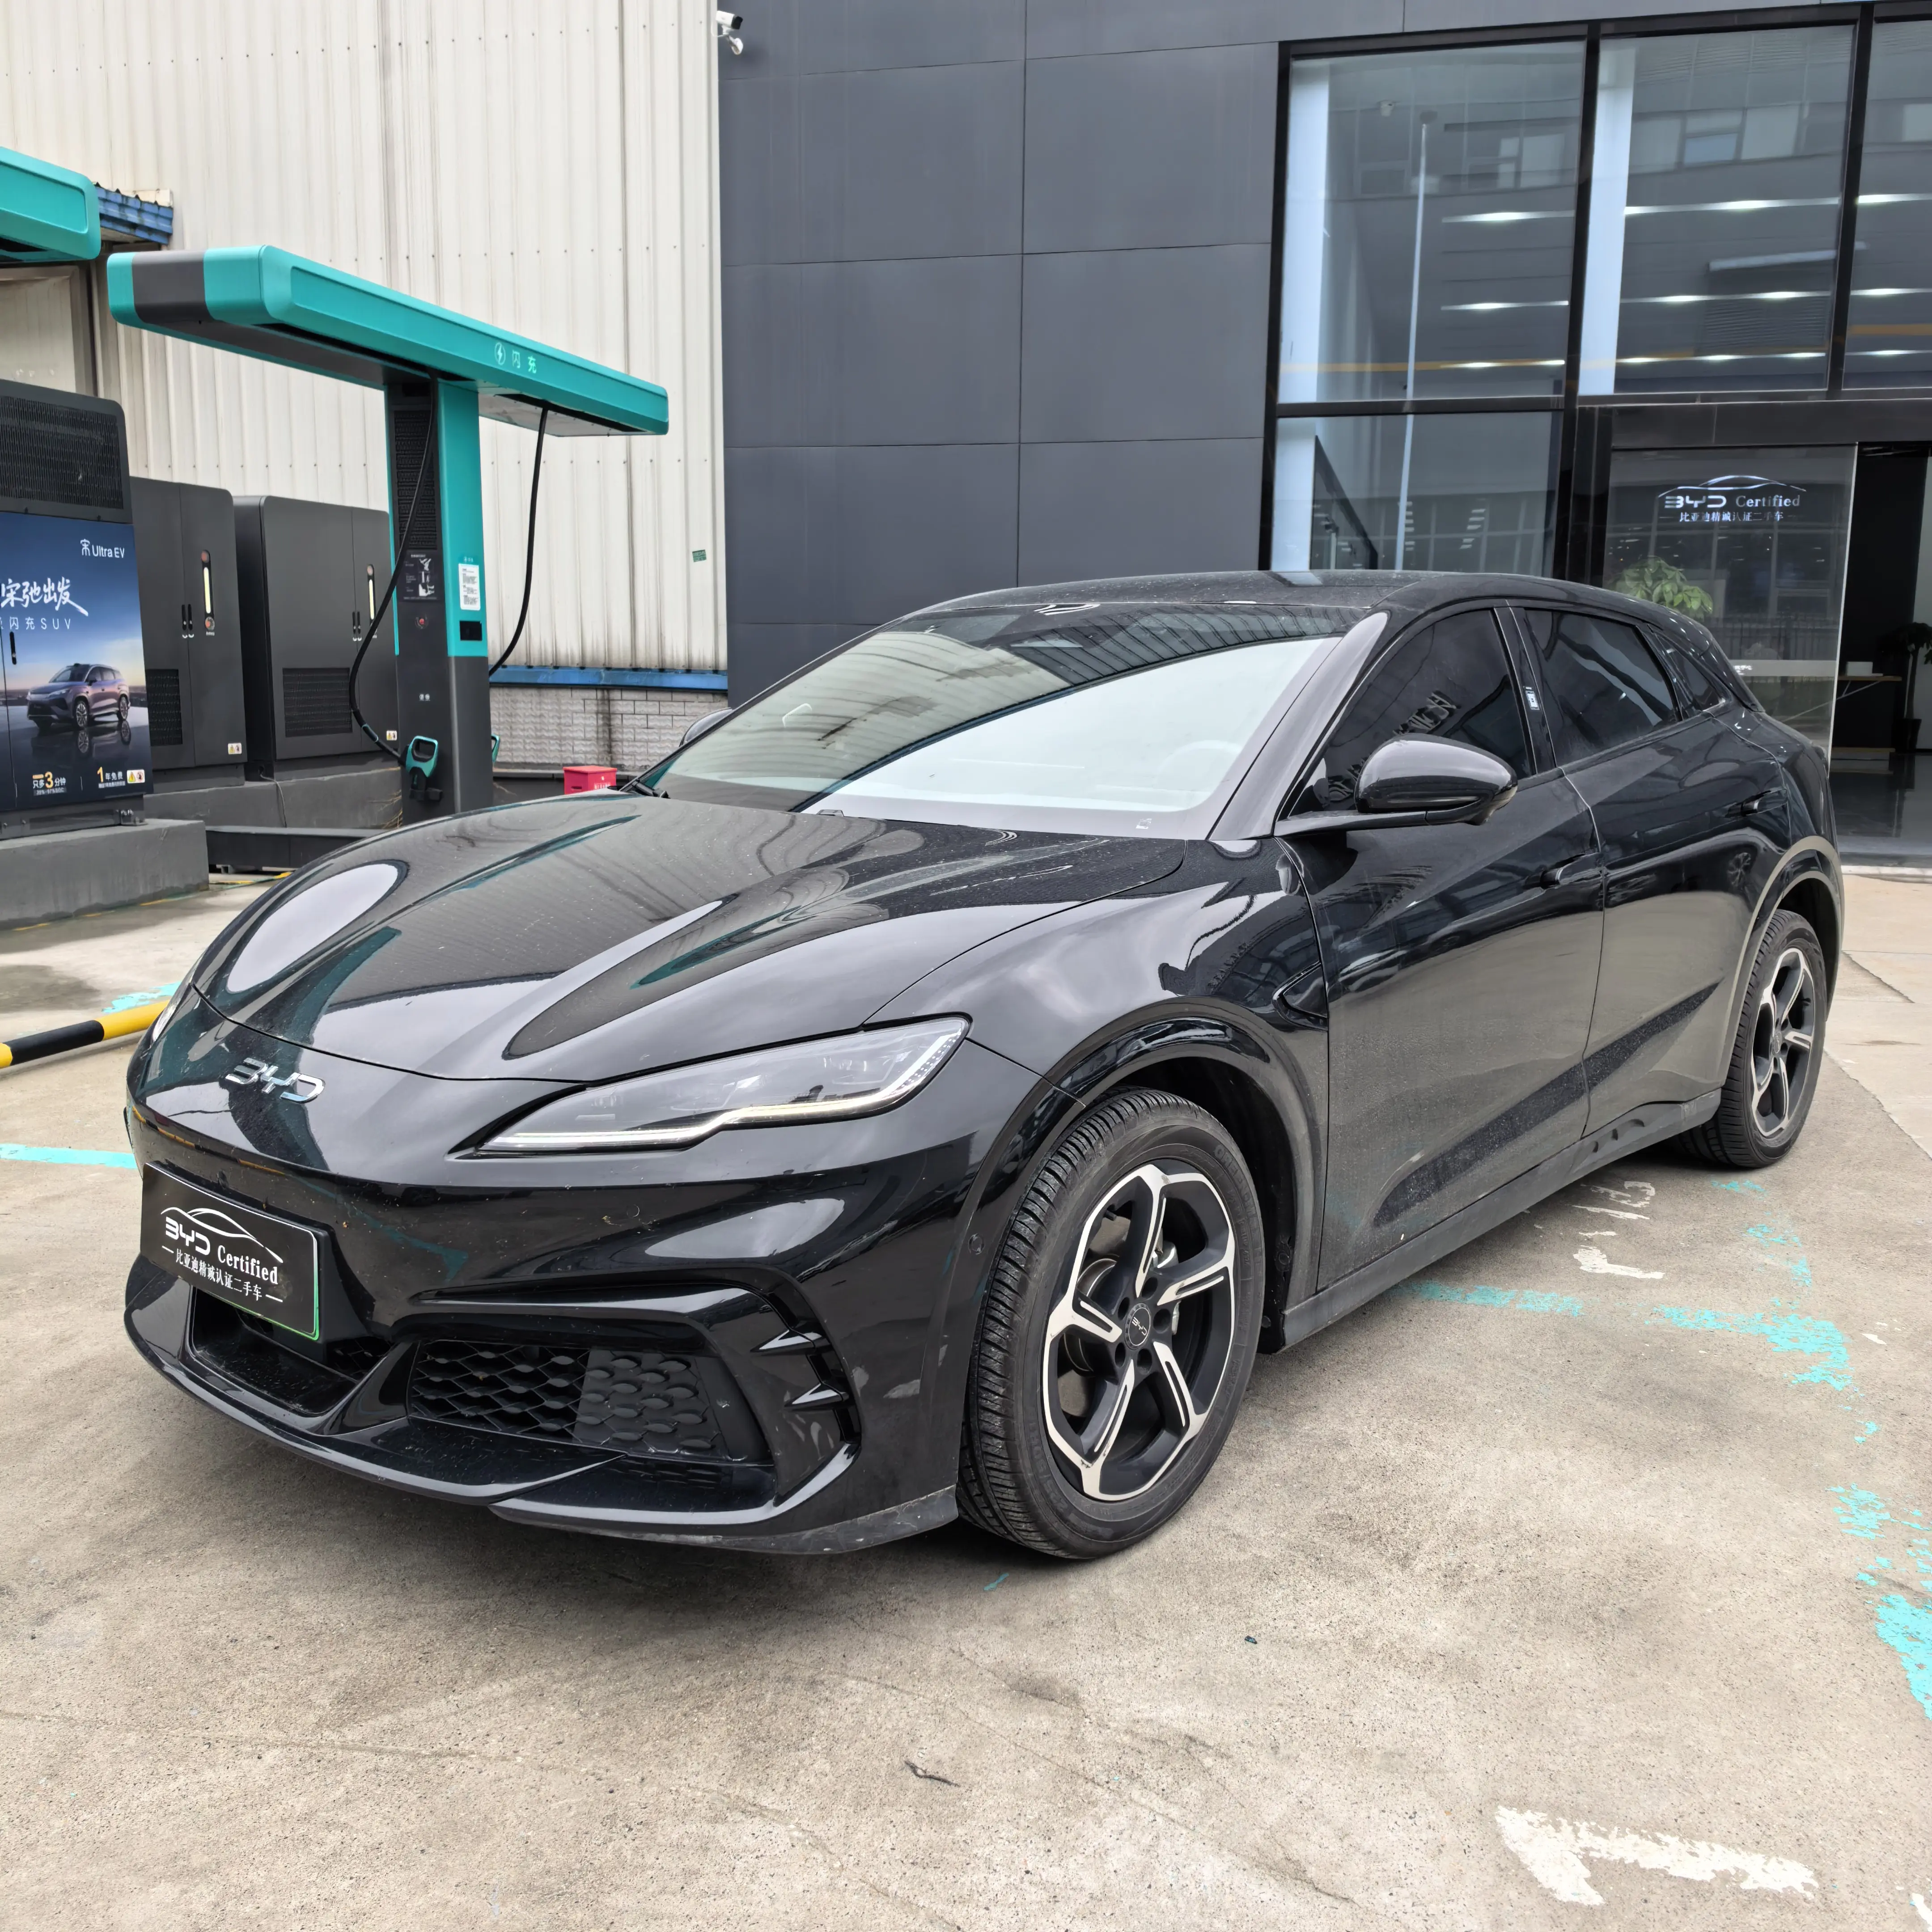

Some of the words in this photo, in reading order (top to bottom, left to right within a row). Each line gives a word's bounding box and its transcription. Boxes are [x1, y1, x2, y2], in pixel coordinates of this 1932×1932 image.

[512, 351, 536, 373] 闪充
[1664, 495, 1727, 508] BYD
[1736, 494, 1801, 507] Certified
[92, 544, 112, 558] Ultra
[114, 547, 125, 558] EV
[225, 1057, 326, 1104] BYD
[165, 1216, 211, 1255] BYD
[217, 1245, 279, 1285] Certified
[175, 1248, 262, 1301] 比亚迪精诚认证二手车
[1131, 1317, 1148, 1336] BYD
